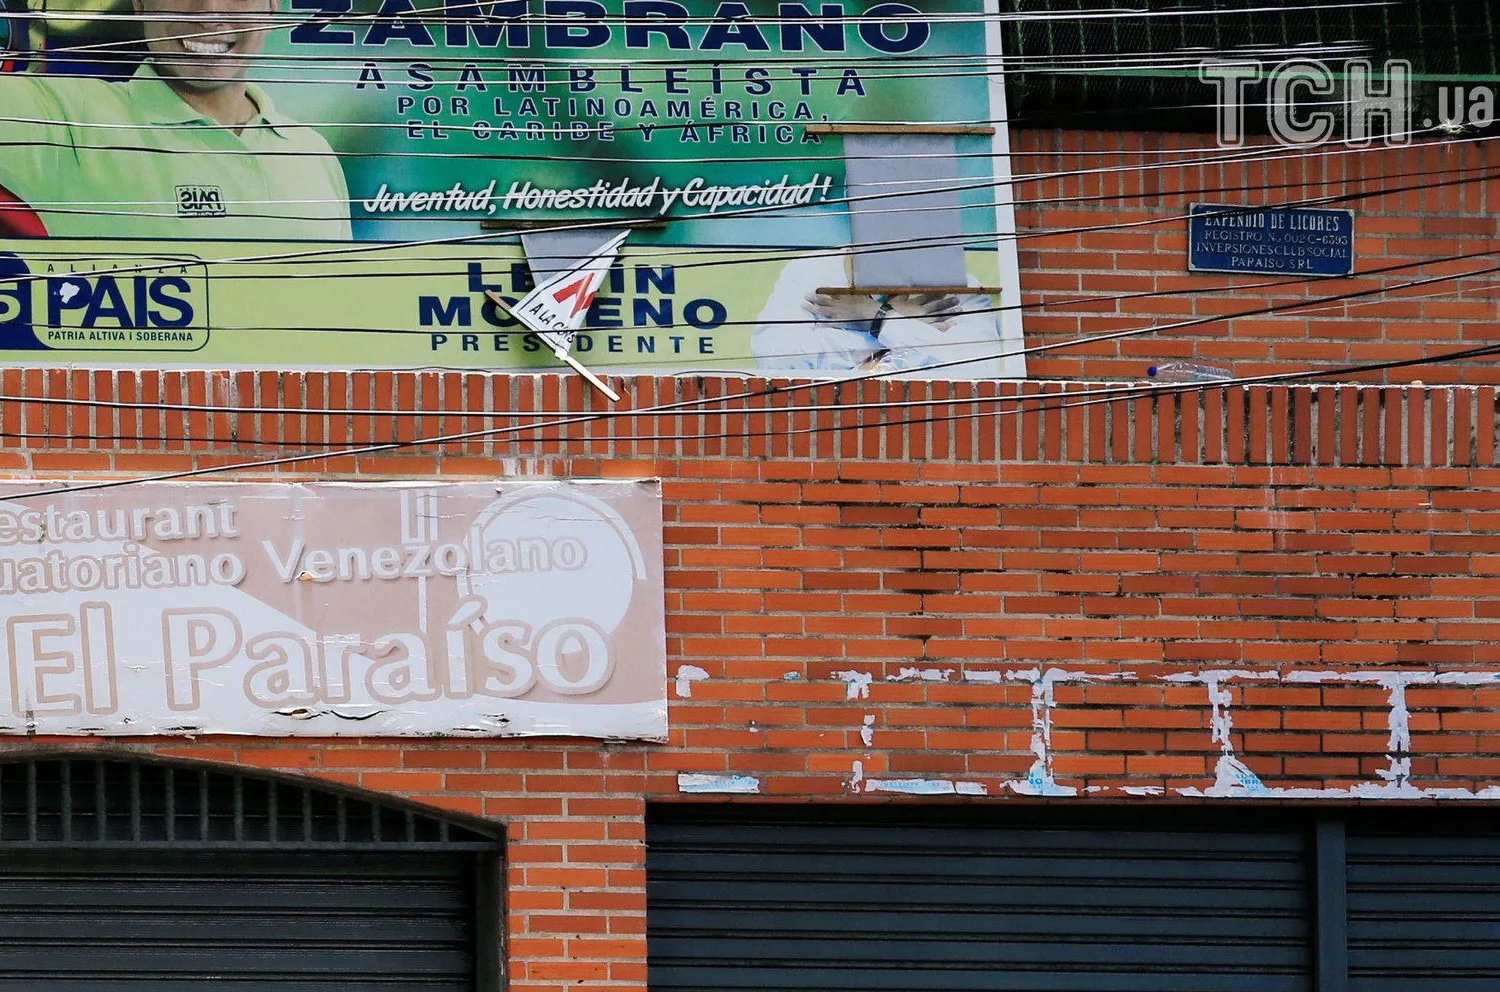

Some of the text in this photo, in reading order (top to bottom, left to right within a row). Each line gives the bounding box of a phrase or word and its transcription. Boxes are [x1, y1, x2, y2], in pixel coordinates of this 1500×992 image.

[289, 0, 932, 54] ZAMBRANO
[356, 61, 867, 97] ASAMBLEÍSTA
[397, 96, 829, 122] POR LATINOAMÉRICA,
[406, 119, 822, 144] EL CARIBE Y ÁFRICA
[362, 179, 497, 215] Juventud,
[503, 176, 664, 212] Honestidad
[659, 187, 681, 214] y
[1271, 213, 1285, 229] DE
[1289, 214, 1340, 231] LICORES
[1204, 229, 1263, 242] REGISTRO
[47, 263, 188, 274] ALIANZA
[1231, 256, 1314, 269] PARAISO SRL
[46, 275, 195, 329] PAIS
[418, 296, 728, 330] MOENO
[48, 330, 86, 341] PATRIA
[89, 330, 127, 341] ALTIVA
[135, 331, 194, 342] SOBERANA
[431, 333, 715, 354] PRESDENTE
[260, 525, 588, 584] Venezolano
[6, 594, 616, 717] El Paraíso
